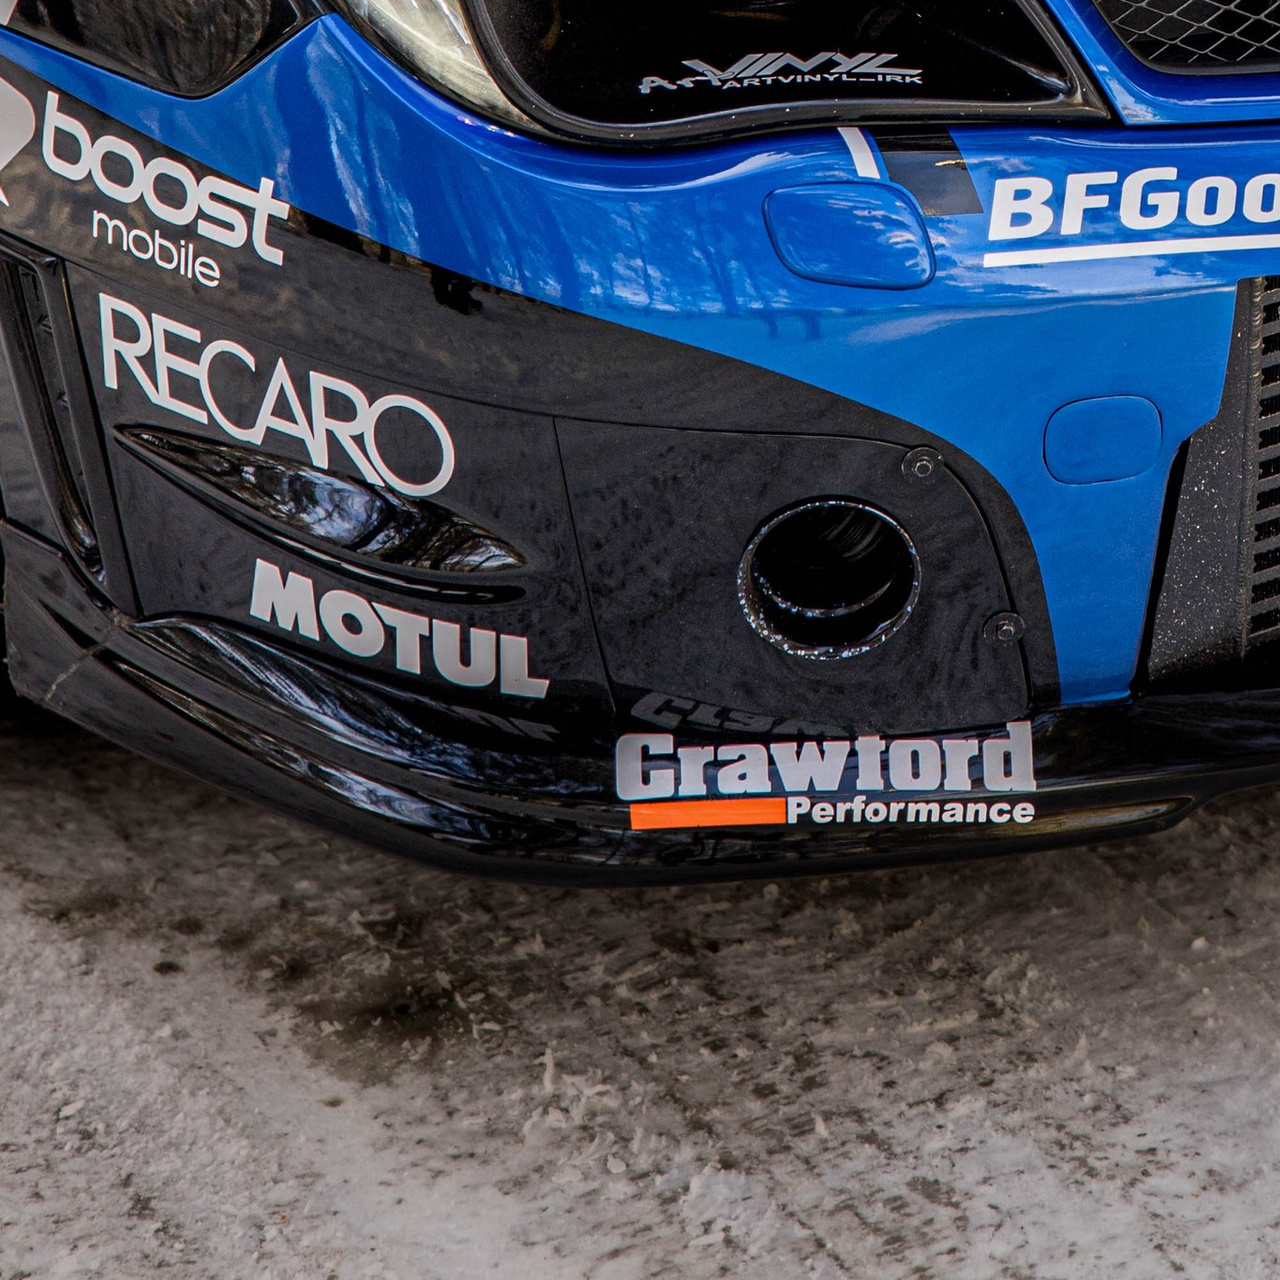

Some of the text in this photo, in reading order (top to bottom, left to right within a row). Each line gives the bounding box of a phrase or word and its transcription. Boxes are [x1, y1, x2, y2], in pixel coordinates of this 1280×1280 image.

[681, 51, 923, 77] VINYL
[722, 73, 923, 90] ARTVINYL_IRK
[42, 90, 290, 266] boost
[93, 208, 221, 288] mobile
[98, 292, 456, 497] RECARO
[249, 557, 550, 699] MOTUL
[615, 719, 1037, 802] Crawford
[787, 794, 1036, 826] Performance
